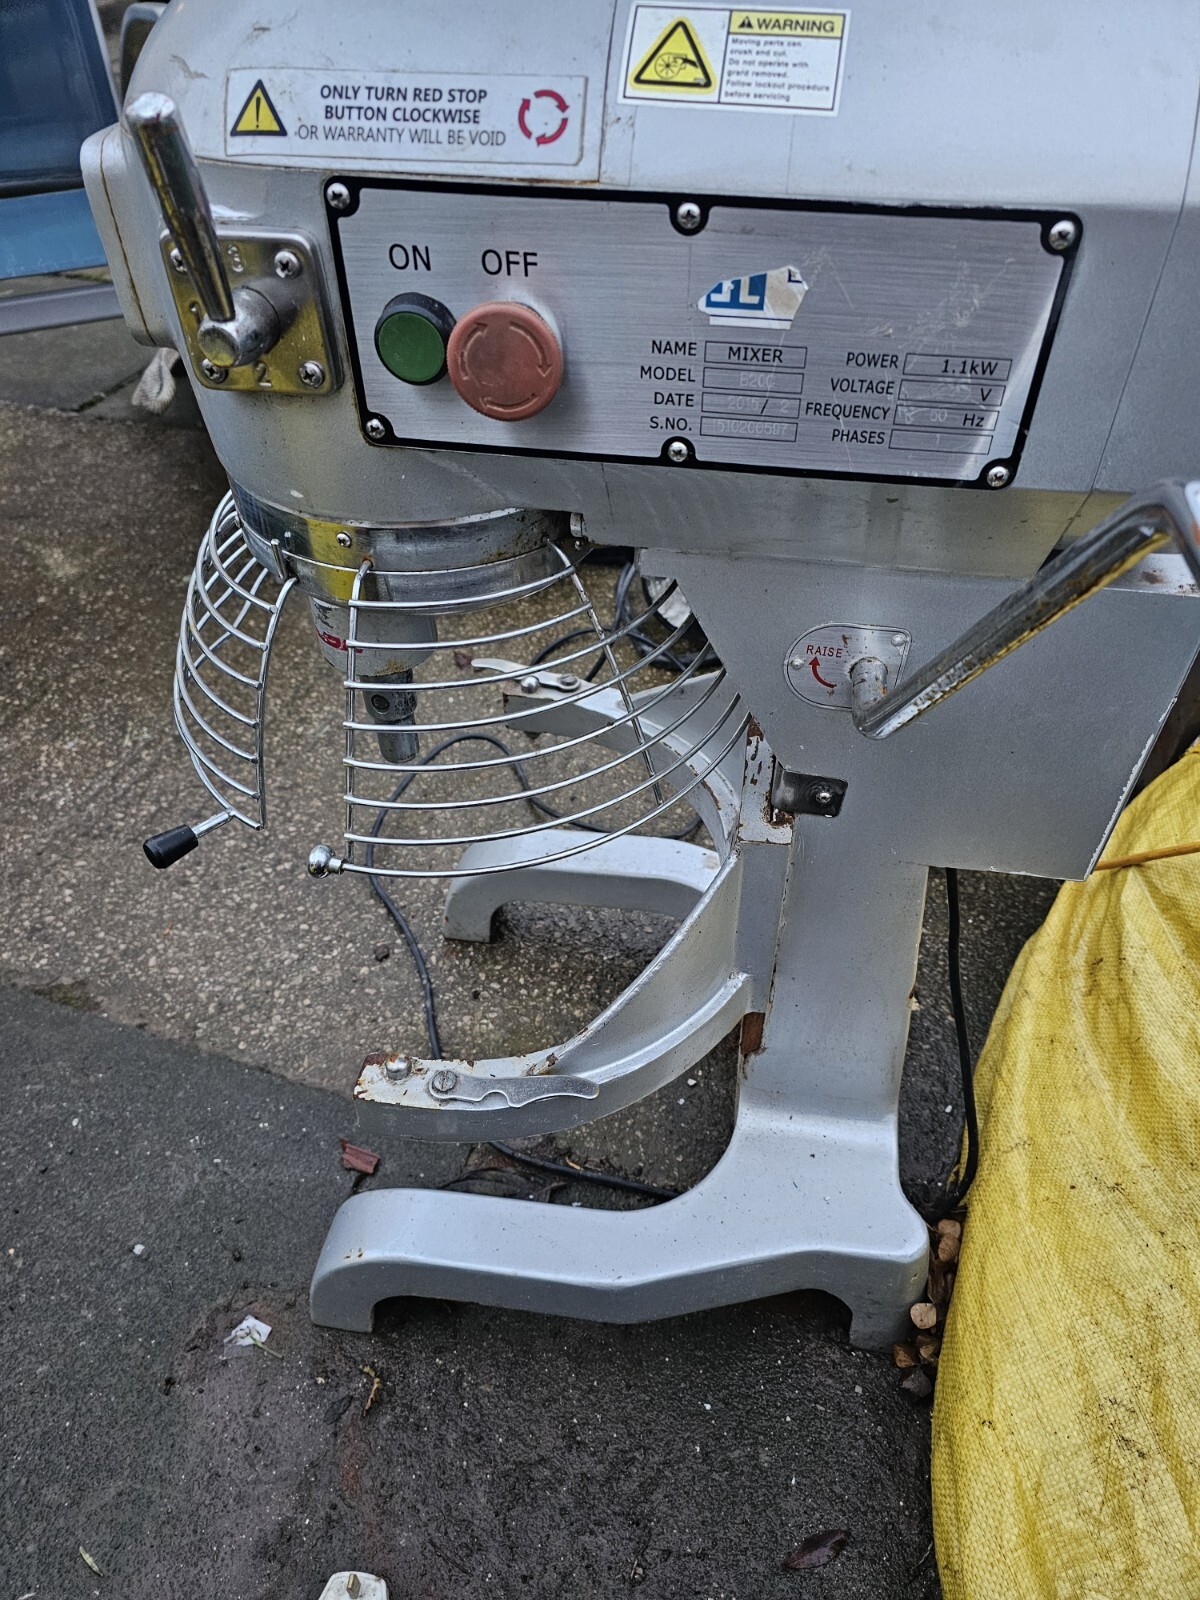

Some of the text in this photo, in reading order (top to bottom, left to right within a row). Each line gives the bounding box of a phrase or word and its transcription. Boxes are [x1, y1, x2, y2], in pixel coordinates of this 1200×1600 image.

[757, 18, 835, 33] WARNING
[732, 38, 761, 47] Moving
[758, 60, 788, 68] operate
[320, 85, 487, 103] ONLY TURN RED STOP
[726, 79, 830, 92] Follow lockout procedure
[725, 90, 790, 102] before servicing
[325, 105, 481, 124] BUTTON CLOCKWISE
[298, 124, 506, 146] OR WARRANTY WILL BE VOID
[389, 244, 431, 271] ON
[481, 249, 538, 277] OFF
[651, 339, 783, 363] NAME MIXER
[846, 352, 998, 376] POWER 1.1kW
[640, 365, 695, 382] MODEL
[830, 377, 992, 402] VOLTAGE V
[654, 392, 694, 407] DATE
[805, 402, 890, 420] FREQUENCY
[963, 413, 985, 428] Hz
[649, 416, 692, 432] S.NO.
[831, 428, 885, 445] PHASES
[806, 644, 843, 658] RAISE
